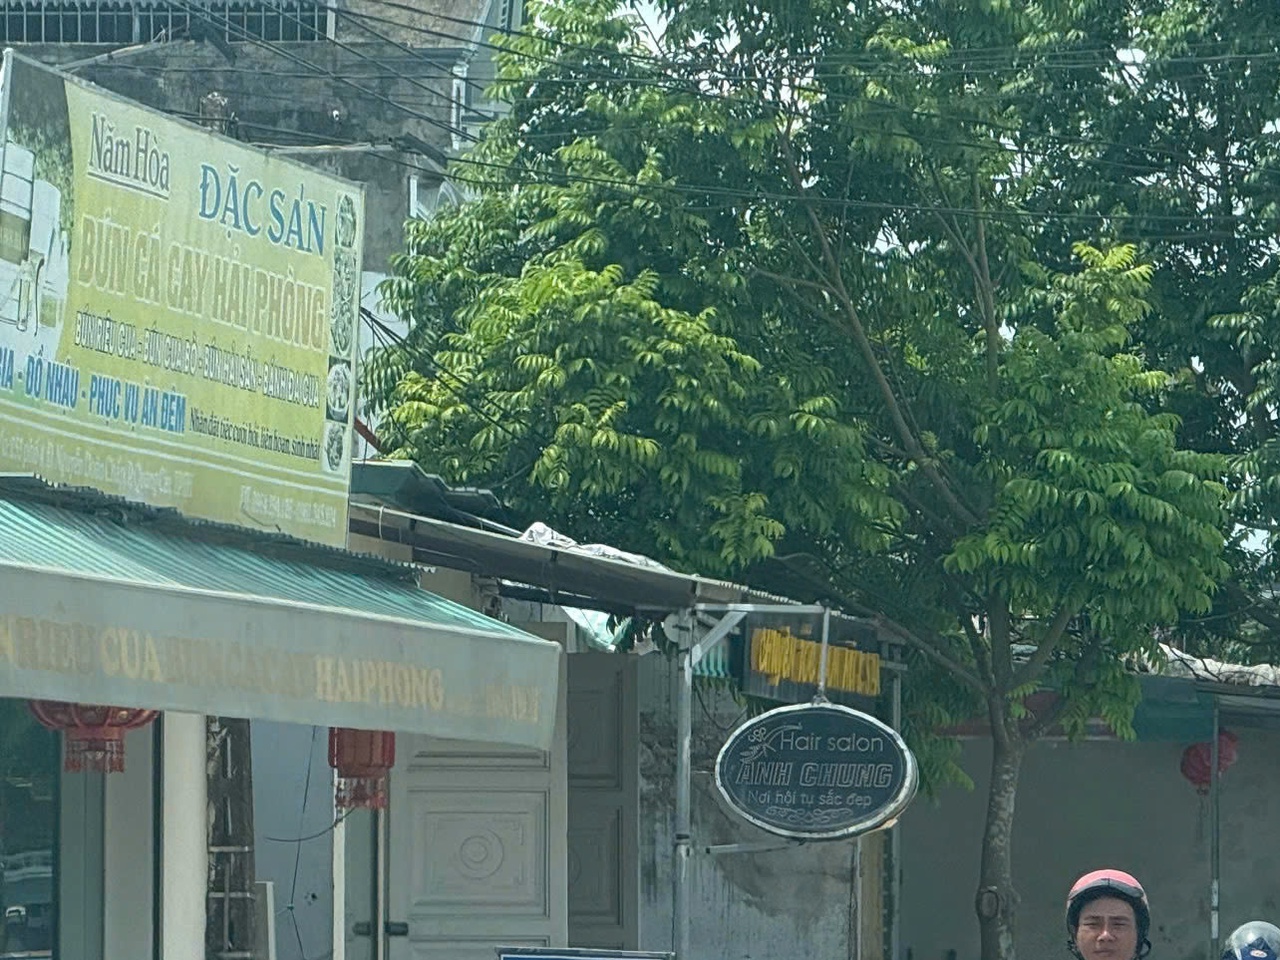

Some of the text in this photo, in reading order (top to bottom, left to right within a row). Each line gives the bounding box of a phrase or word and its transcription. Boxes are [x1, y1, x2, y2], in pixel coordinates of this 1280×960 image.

[88, 113, 170, 192] Năm Hòa
[199, 162, 264, 240] ĐẶC
[77, 208, 131, 296] BÚN
[133, 222, 162, 306] CÁ
[167, 243, 210, 317] CAY
[100, 627, 162, 682] CUA
[780, 730, 884, 752] Hair salon
[736, 761, 893, 788] ANH CHUNG
